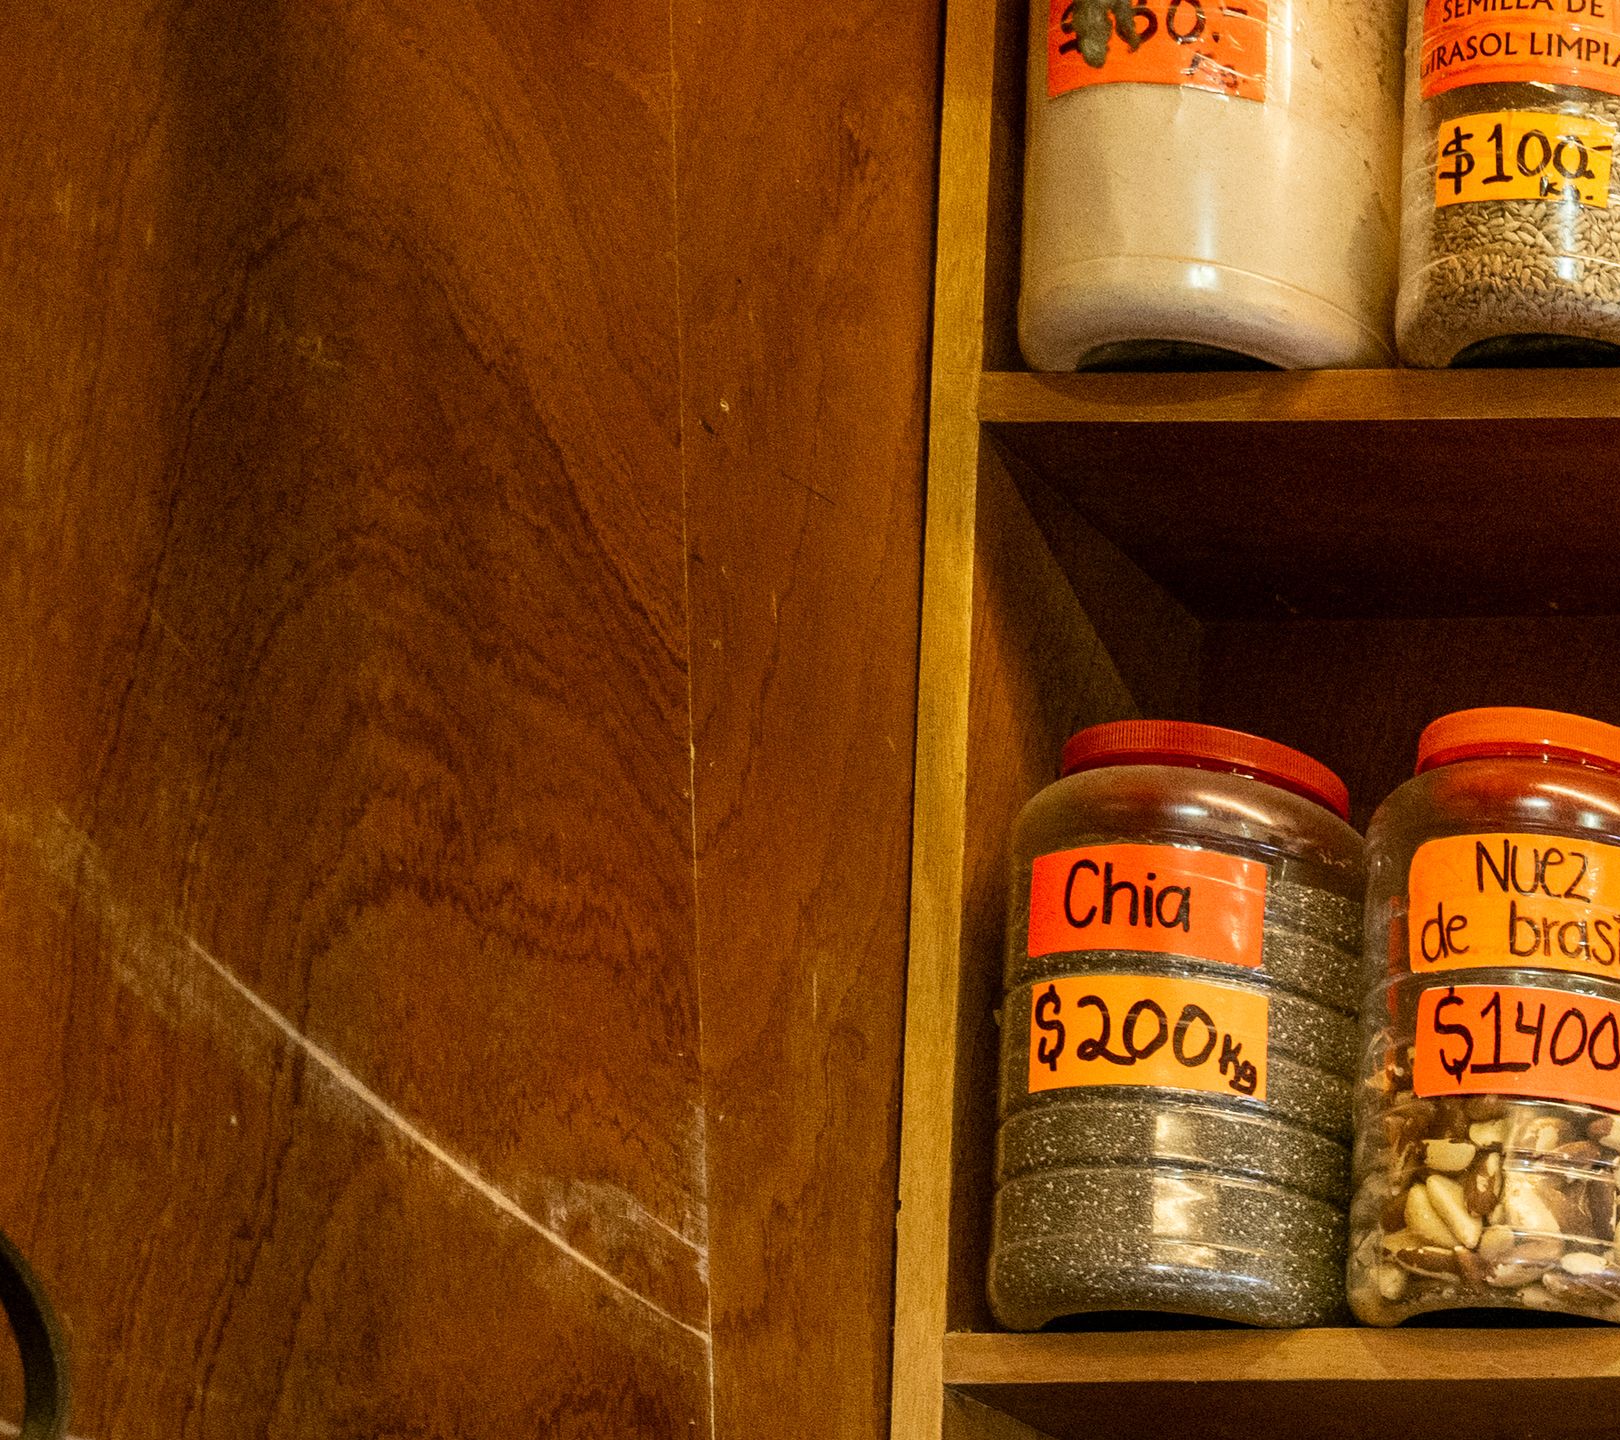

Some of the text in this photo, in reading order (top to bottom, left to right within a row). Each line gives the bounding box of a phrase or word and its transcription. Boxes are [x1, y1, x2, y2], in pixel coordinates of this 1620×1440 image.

[1064, 859, 1192, 932] Chia
[1476, 839, 1592, 904] Nuez
[1421, 902, 1470, 964] de
[1034, 983, 1258, 1096] $200 Kg
